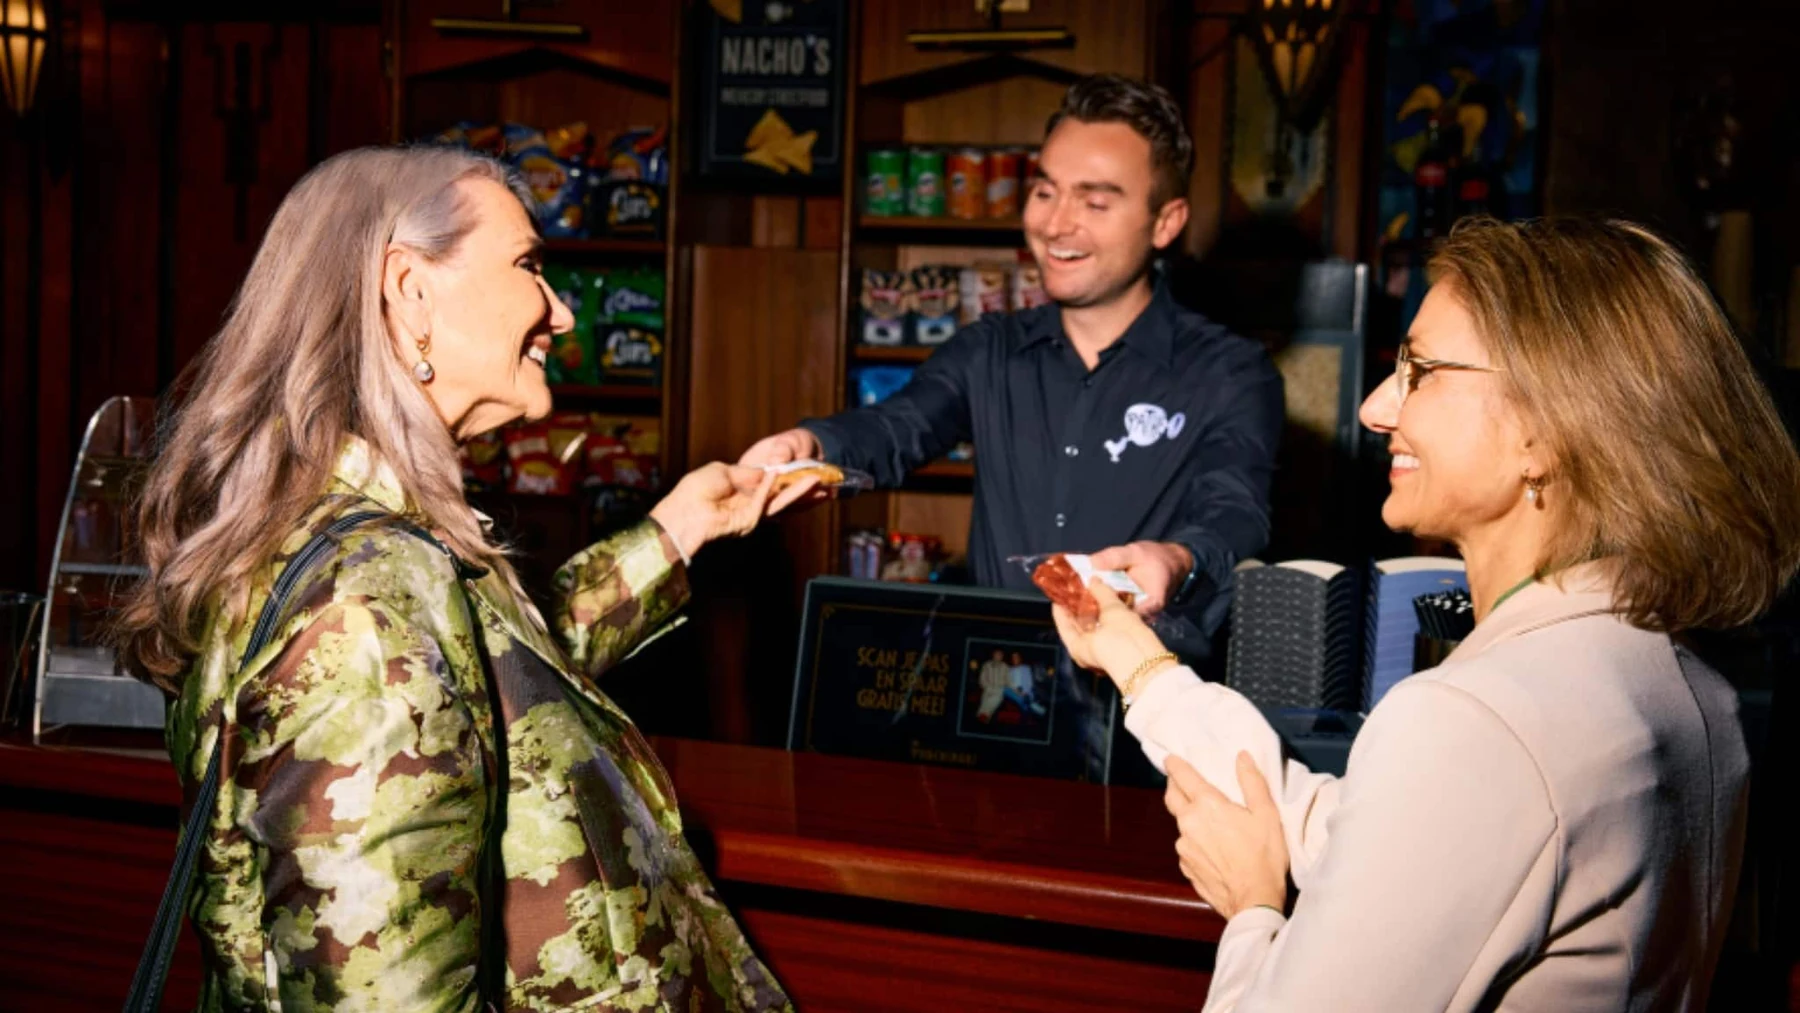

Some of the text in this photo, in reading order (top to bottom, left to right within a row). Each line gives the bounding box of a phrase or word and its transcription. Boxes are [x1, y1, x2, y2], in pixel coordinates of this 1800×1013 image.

[721, 35, 830, 75] NACHO'S
[857, 647, 897, 667] SCAN
[901, 650, 918, 669] JE
[876, 670, 948, 692] EN SPAAR
